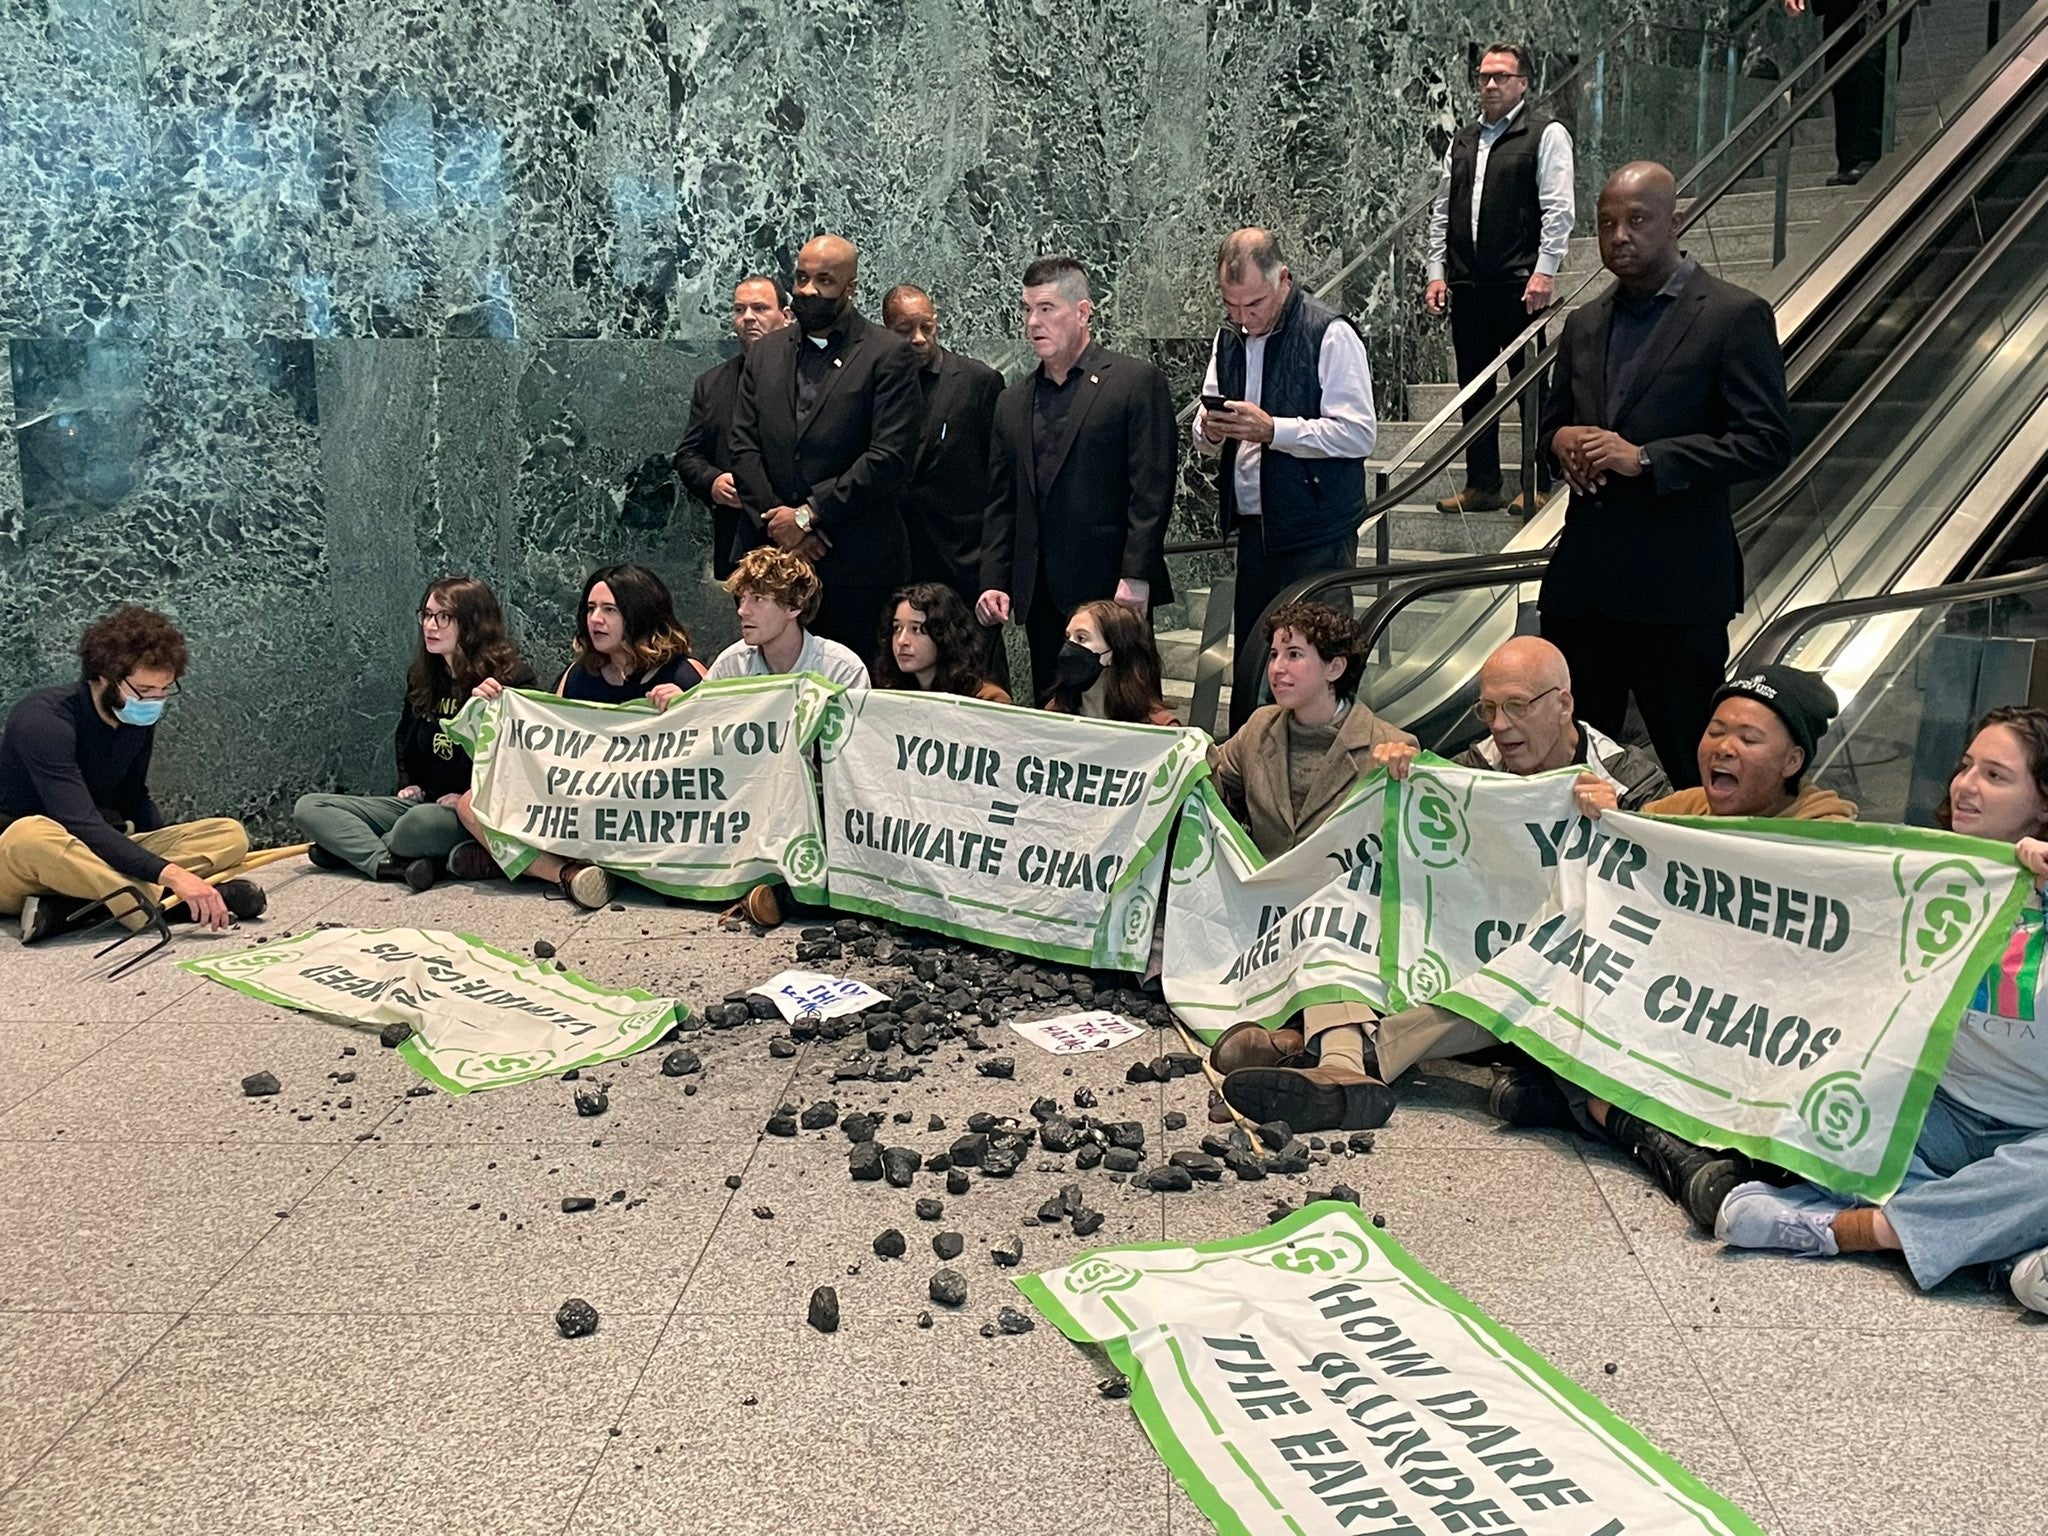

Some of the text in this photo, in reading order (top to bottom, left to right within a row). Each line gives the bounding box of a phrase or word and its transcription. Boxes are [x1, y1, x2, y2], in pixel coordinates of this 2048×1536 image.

[602, 728, 699, 763] DARE
[711, 720, 790, 756] YOU
[895, 734, 1147, 807] YOUR GREED
[547, 765, 728, 801] PLUNDER
[522, 804, 751, 844] THE EARTH?
[844, 808, 1124, 894] CLIMATE CHAO
[1290, 906, 1381, 957] KILL
[1663, 860, 1851, 954] GREED
[1642, 974, 1843, 1071] CHAOS
[1965, 1011, 2036, 1040] ECTA
[1200, 1333, 1313, 1420] THE
[1308, 1283, 1595, 1512] HOW DARE
[1297, 1352, 1528, 1536] PLUNDE
